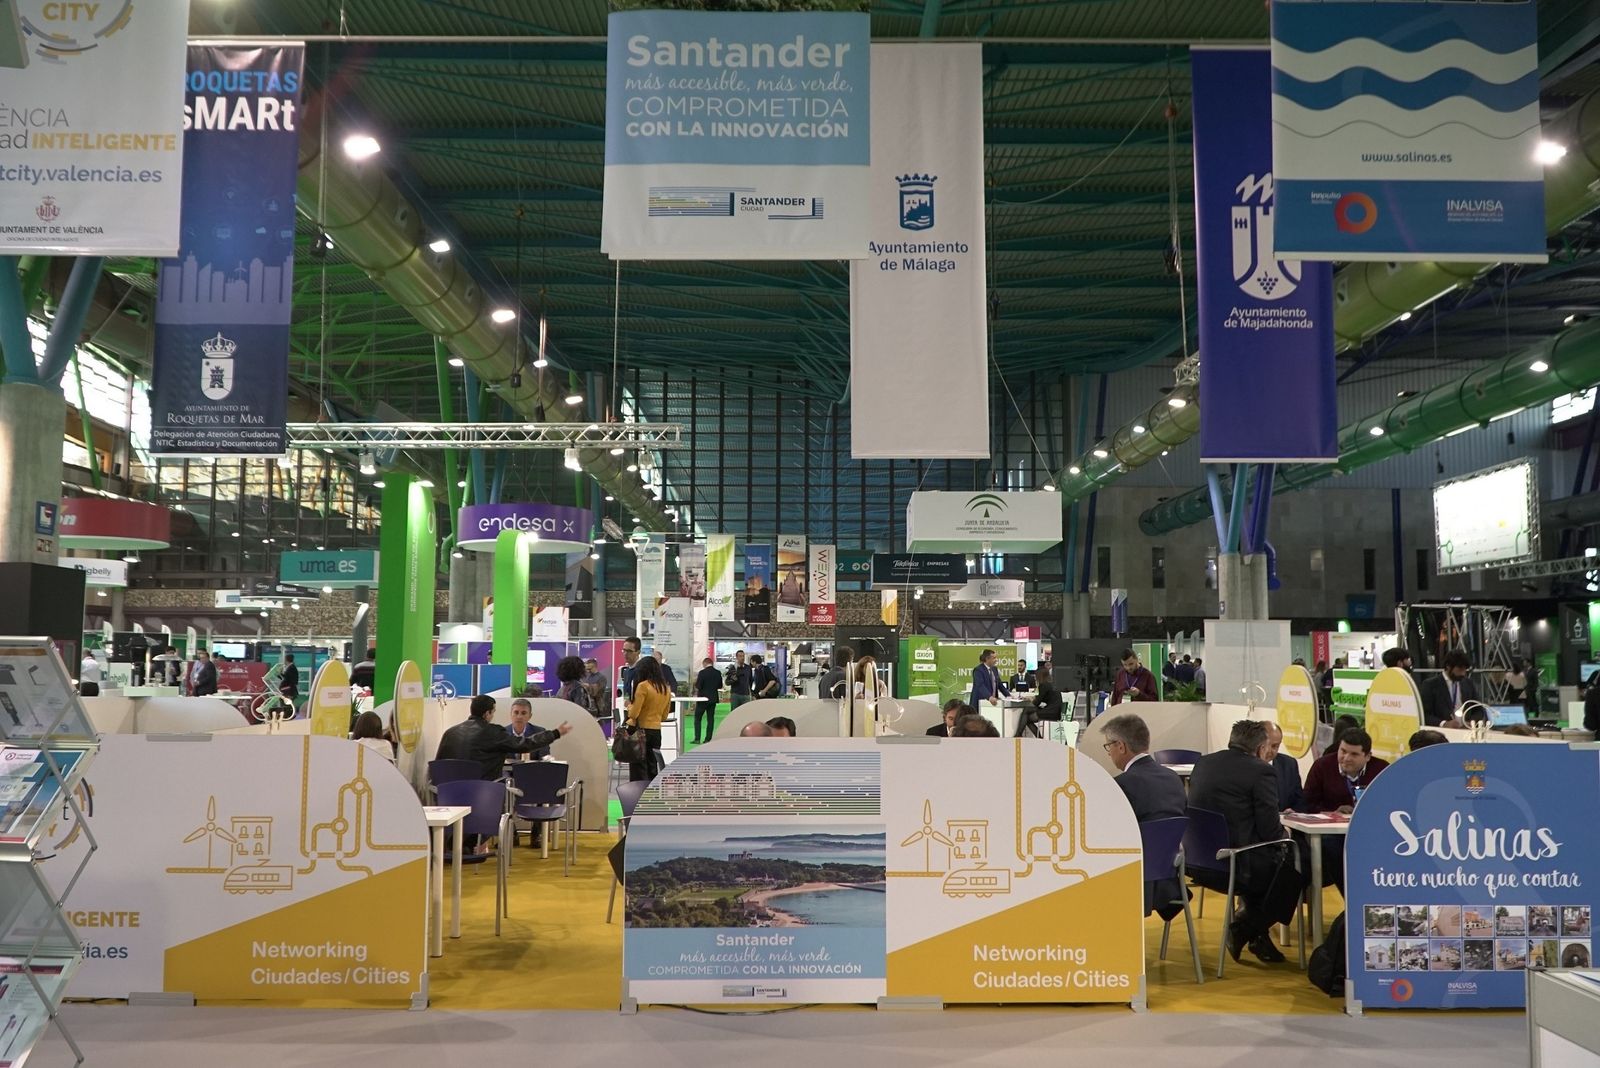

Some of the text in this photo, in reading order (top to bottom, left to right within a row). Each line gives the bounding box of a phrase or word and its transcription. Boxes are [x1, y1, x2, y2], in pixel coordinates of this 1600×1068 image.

[42, 2, 99, 21] CITY
[627, 35, 850, 68] Santander
[625, 70, 854, 92] más accesible, más verde,
[183, 96, 296, 131] sMARt
[626, 96, 849, 118] COMPROMETIDA
[625, 119, 849, 138] CON LA INNOVACIÓN
[31, 132, 177, 151] INTELIGENTE
[1361, 151, 1453, 163] www.salinas.es
[740, 197, 806, 206] SANTANDER
[1446, 199, 1504, 211] INALVISA
[49, 226, 61, 234] DE
[869, 241, 969, 256] Ayuntamiento
[880, 258, 956, 273] de Málaga
[1230, 306, 1307, 319] Ayuntamiento
[1223, 318, 1314, 331] de Majadahonda
[167, 412, 265, 425] ROQUETAS DE MAR
[153, 431, 195, 439] Delegación
[207, 431, 239, 439] Atención
[240, 431, 280, 439] Ciudadana,
[479, 513, 556, 532] endesa
[300, 559, 357, 573] uma.es
[1389, 810, 1564, 861] Salinas
[1371, 866, 1582, 898] tiene mucho que contar
[716, 933, 795, 946] Santander
[252, 941, 368, 962] Networking
[680, 947, 831, 963] más accesible, más verde
[973, 944, 1087, 965] Networking
[648, 962, 862, 976] COMPROMETIDA CON LA INNOVACIÓN
